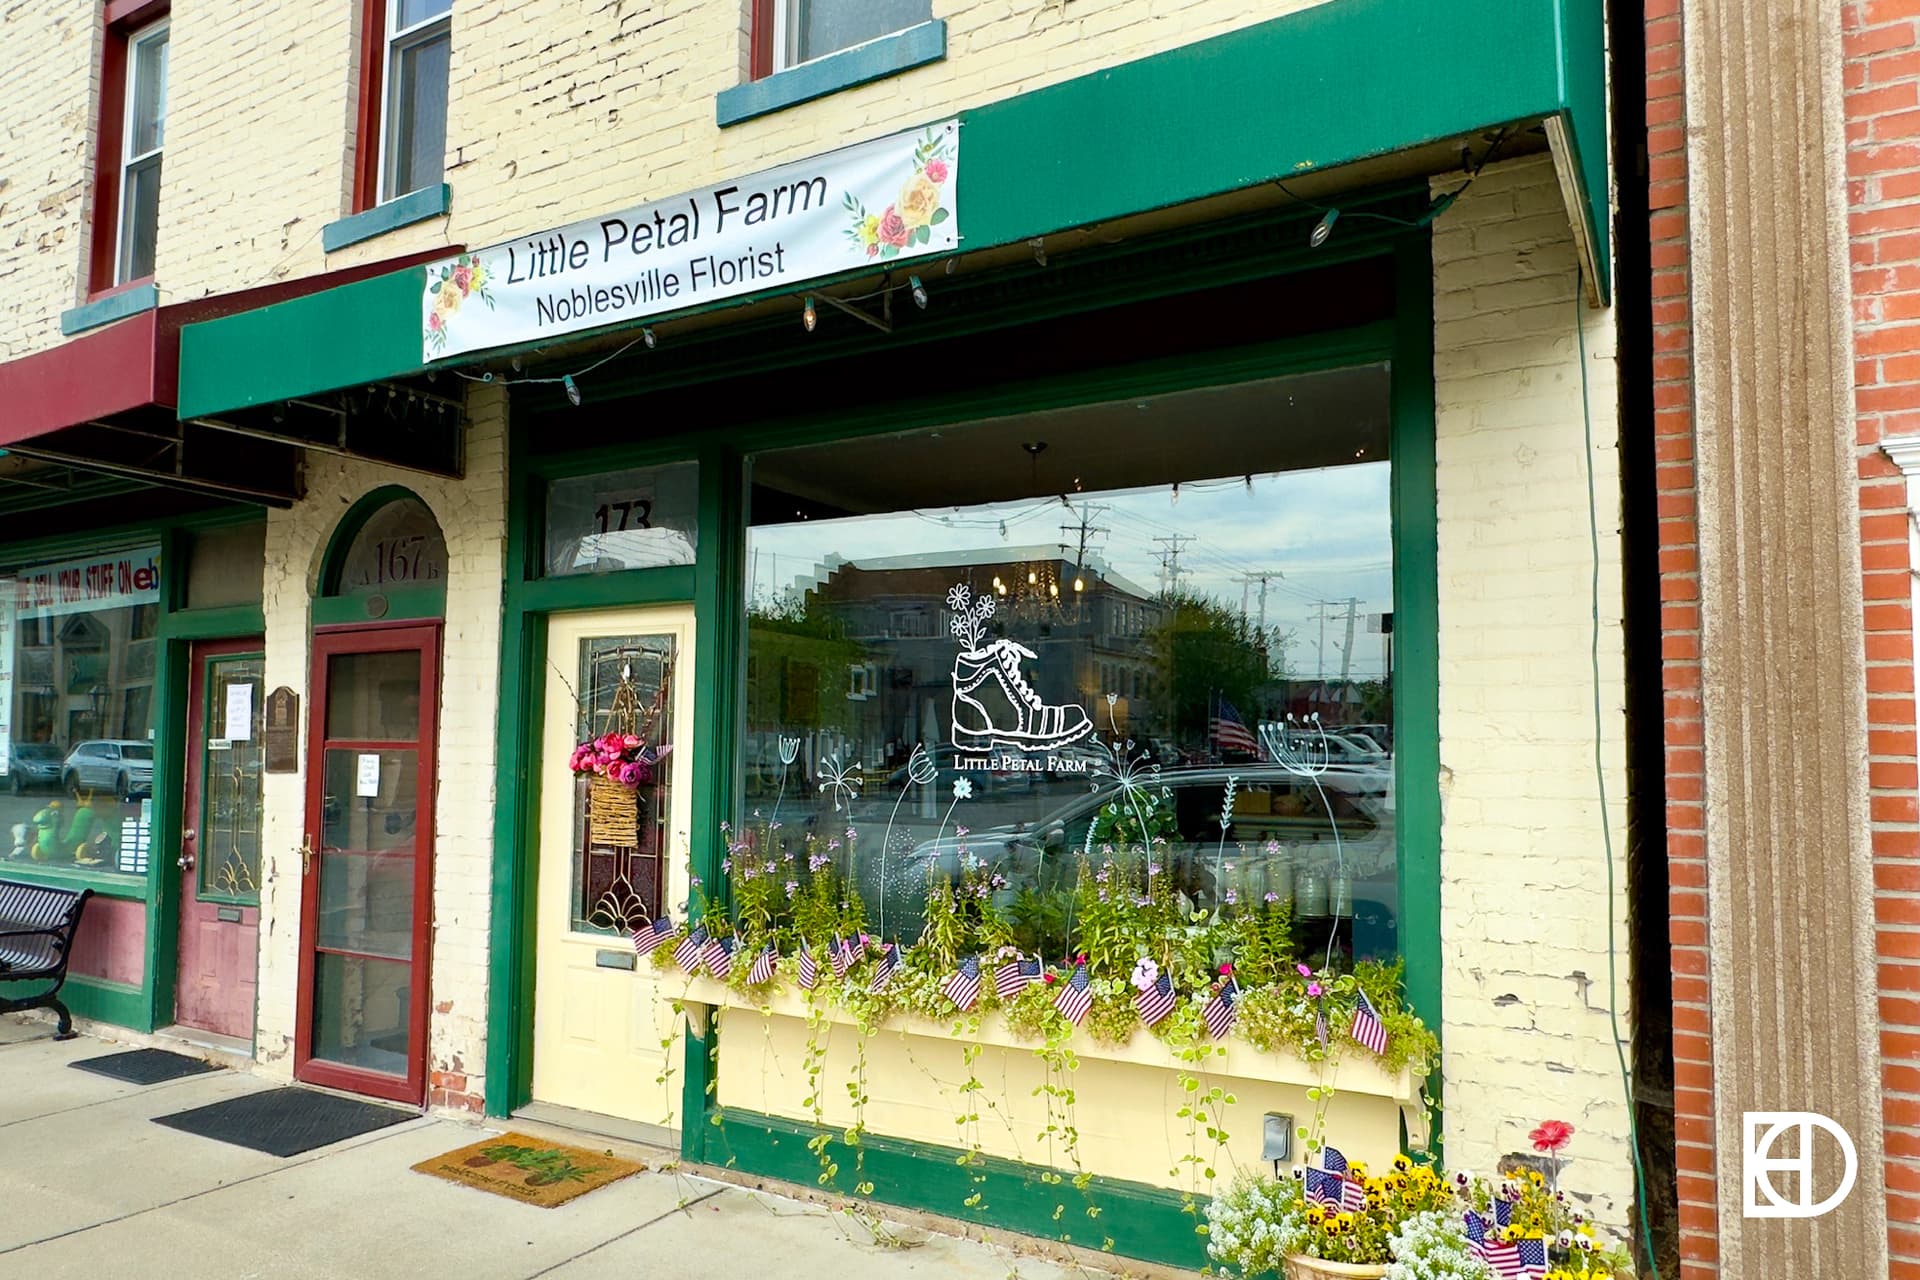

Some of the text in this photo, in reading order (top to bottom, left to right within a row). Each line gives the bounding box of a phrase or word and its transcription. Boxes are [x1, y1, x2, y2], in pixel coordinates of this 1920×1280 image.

[507, 176, 827, 284] Little Petal Farm
[536, 242, 785, 327] Noblesville Florist
[595, 499, 651, 534] 173
[58, 567, 81, 604] YOUR
[86, 562, 114, 600] STUFF
[118, 559, 132, 596] ON
[376, 535, 425, 584] 167
